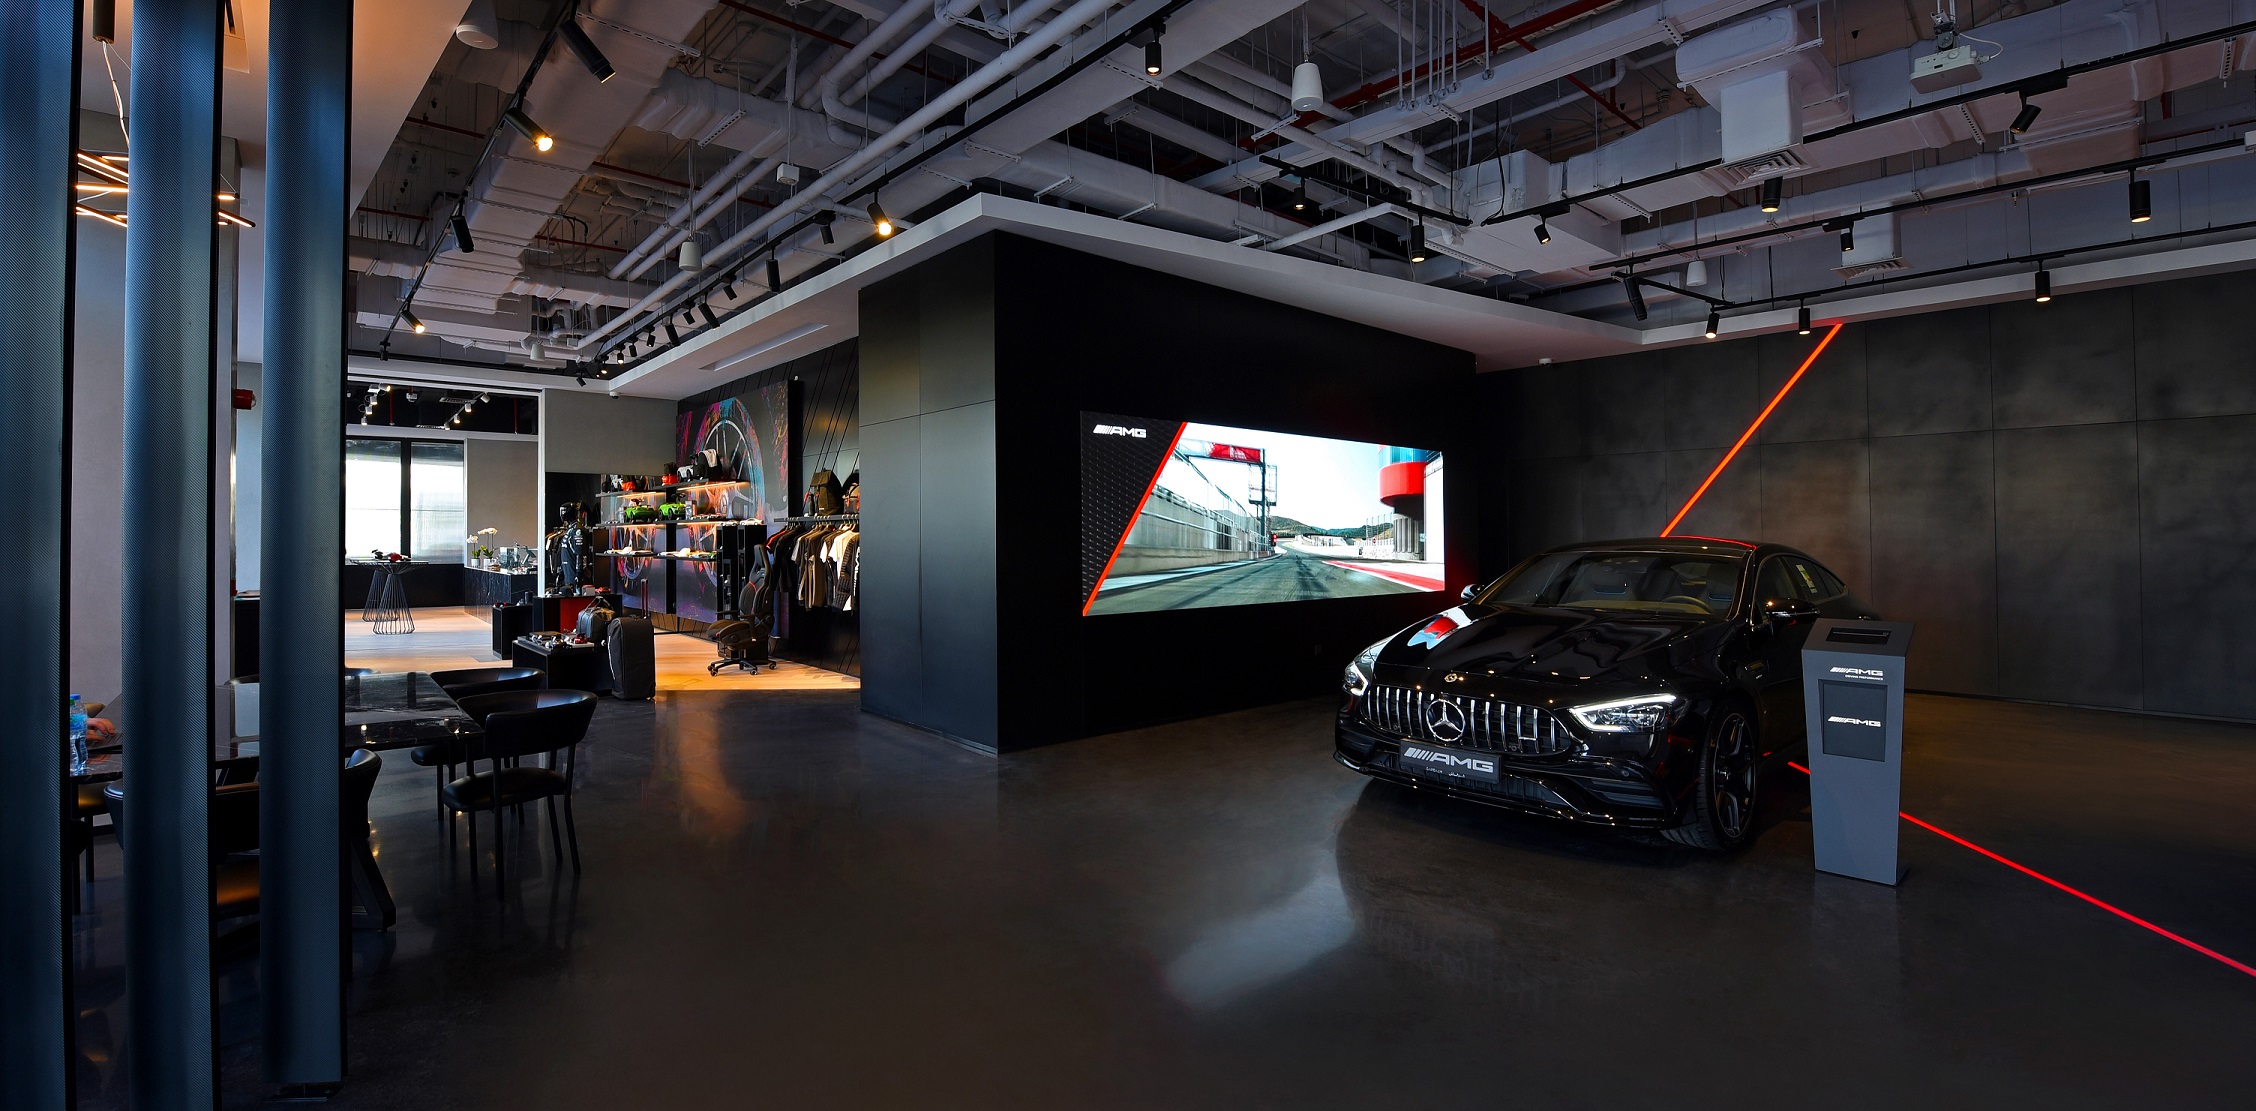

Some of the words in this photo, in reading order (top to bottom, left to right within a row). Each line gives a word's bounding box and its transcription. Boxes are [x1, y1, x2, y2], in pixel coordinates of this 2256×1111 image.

[1110, 426, 1146, 438] AMG
[1845, 668, 1883, 676] AMG
[1844, 718, 1881, 727] AMG
[1430, 752, 1493, 773] AMG
